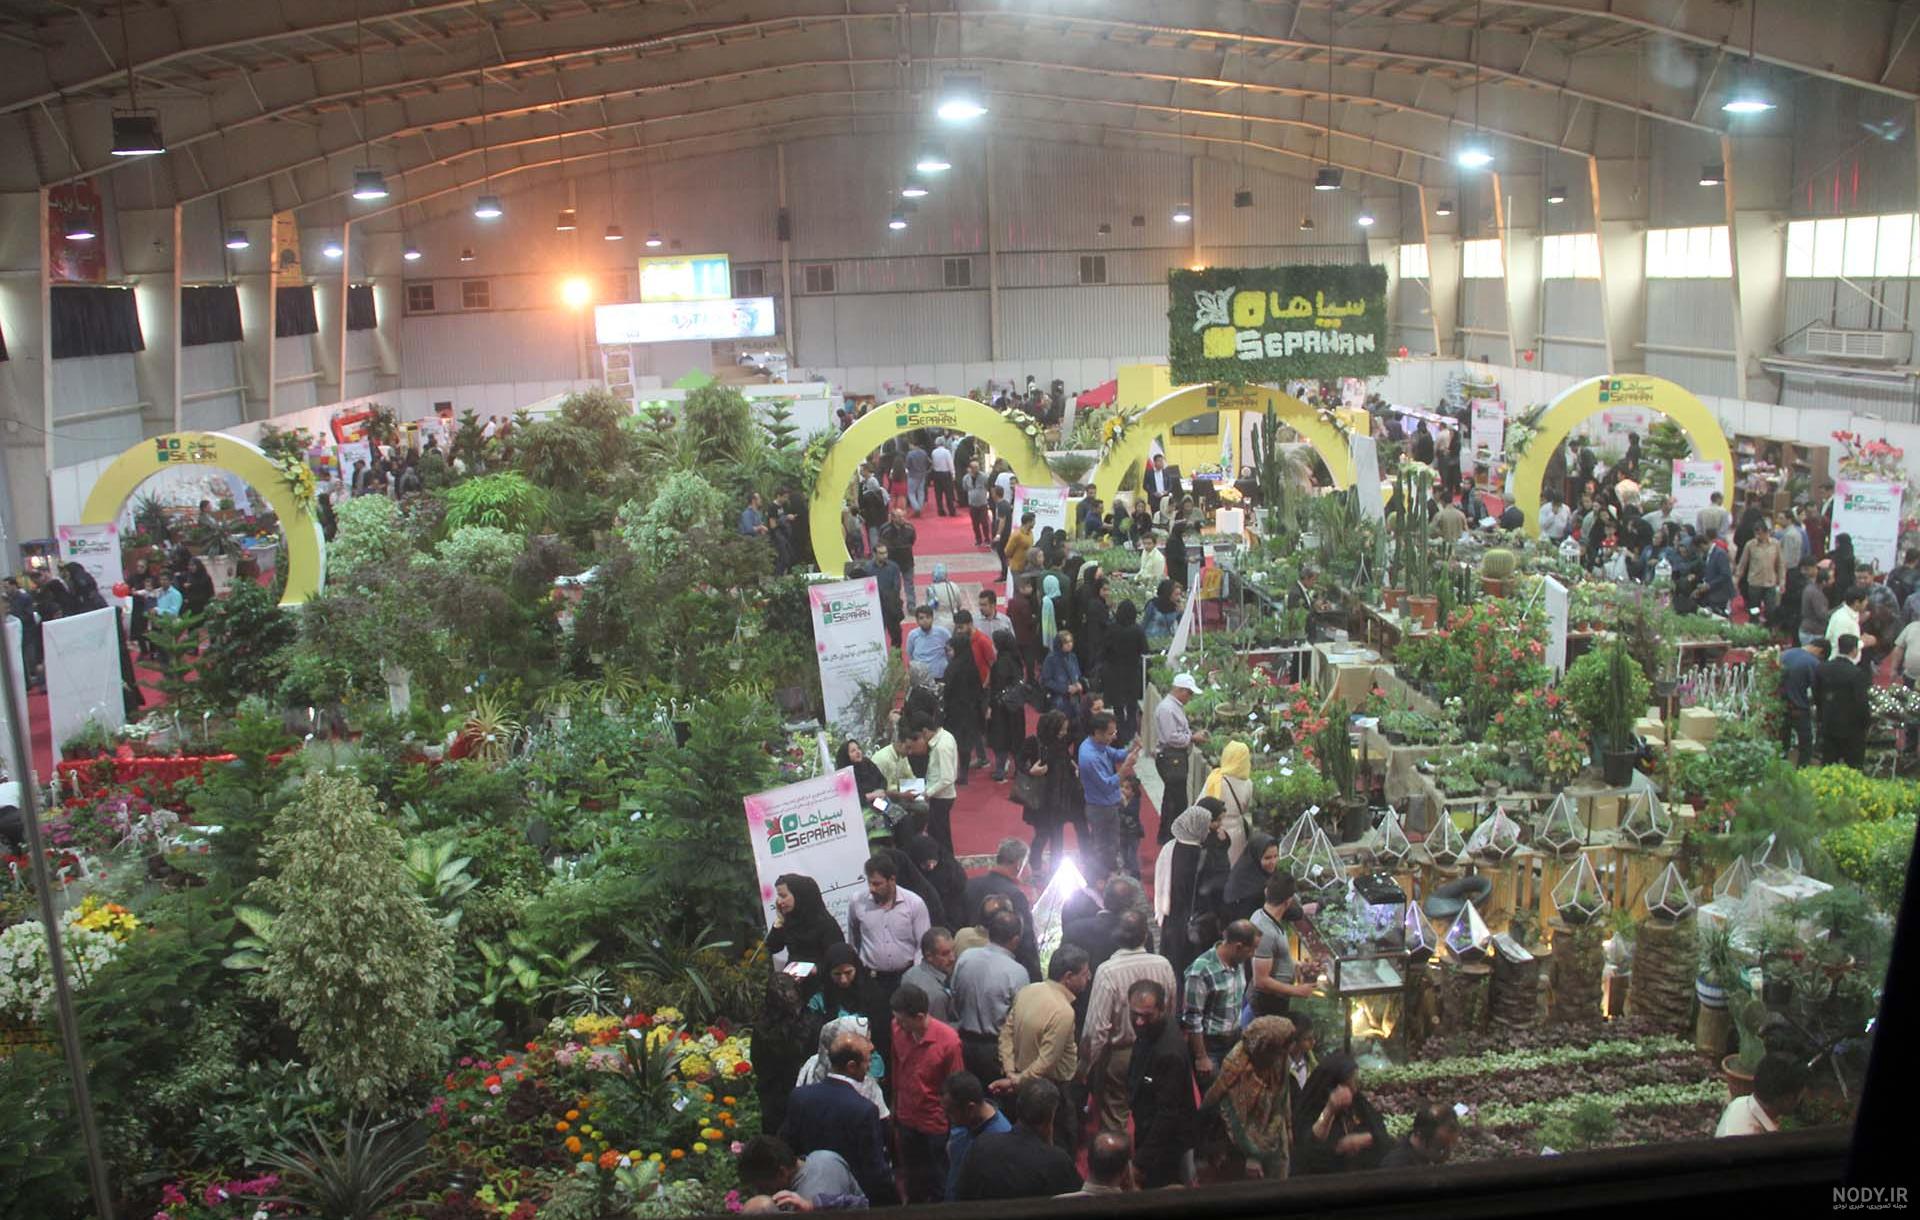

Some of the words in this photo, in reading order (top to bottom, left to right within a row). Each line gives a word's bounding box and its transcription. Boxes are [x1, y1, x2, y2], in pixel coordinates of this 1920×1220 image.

[1236, 329, 1375, 361] SEPAHAN
[908, 415, 957, 426] SEPAHAN
[833, 609, 872, 622] SEPAHAN
[785, 821, 847, 849] SEPAHAN
